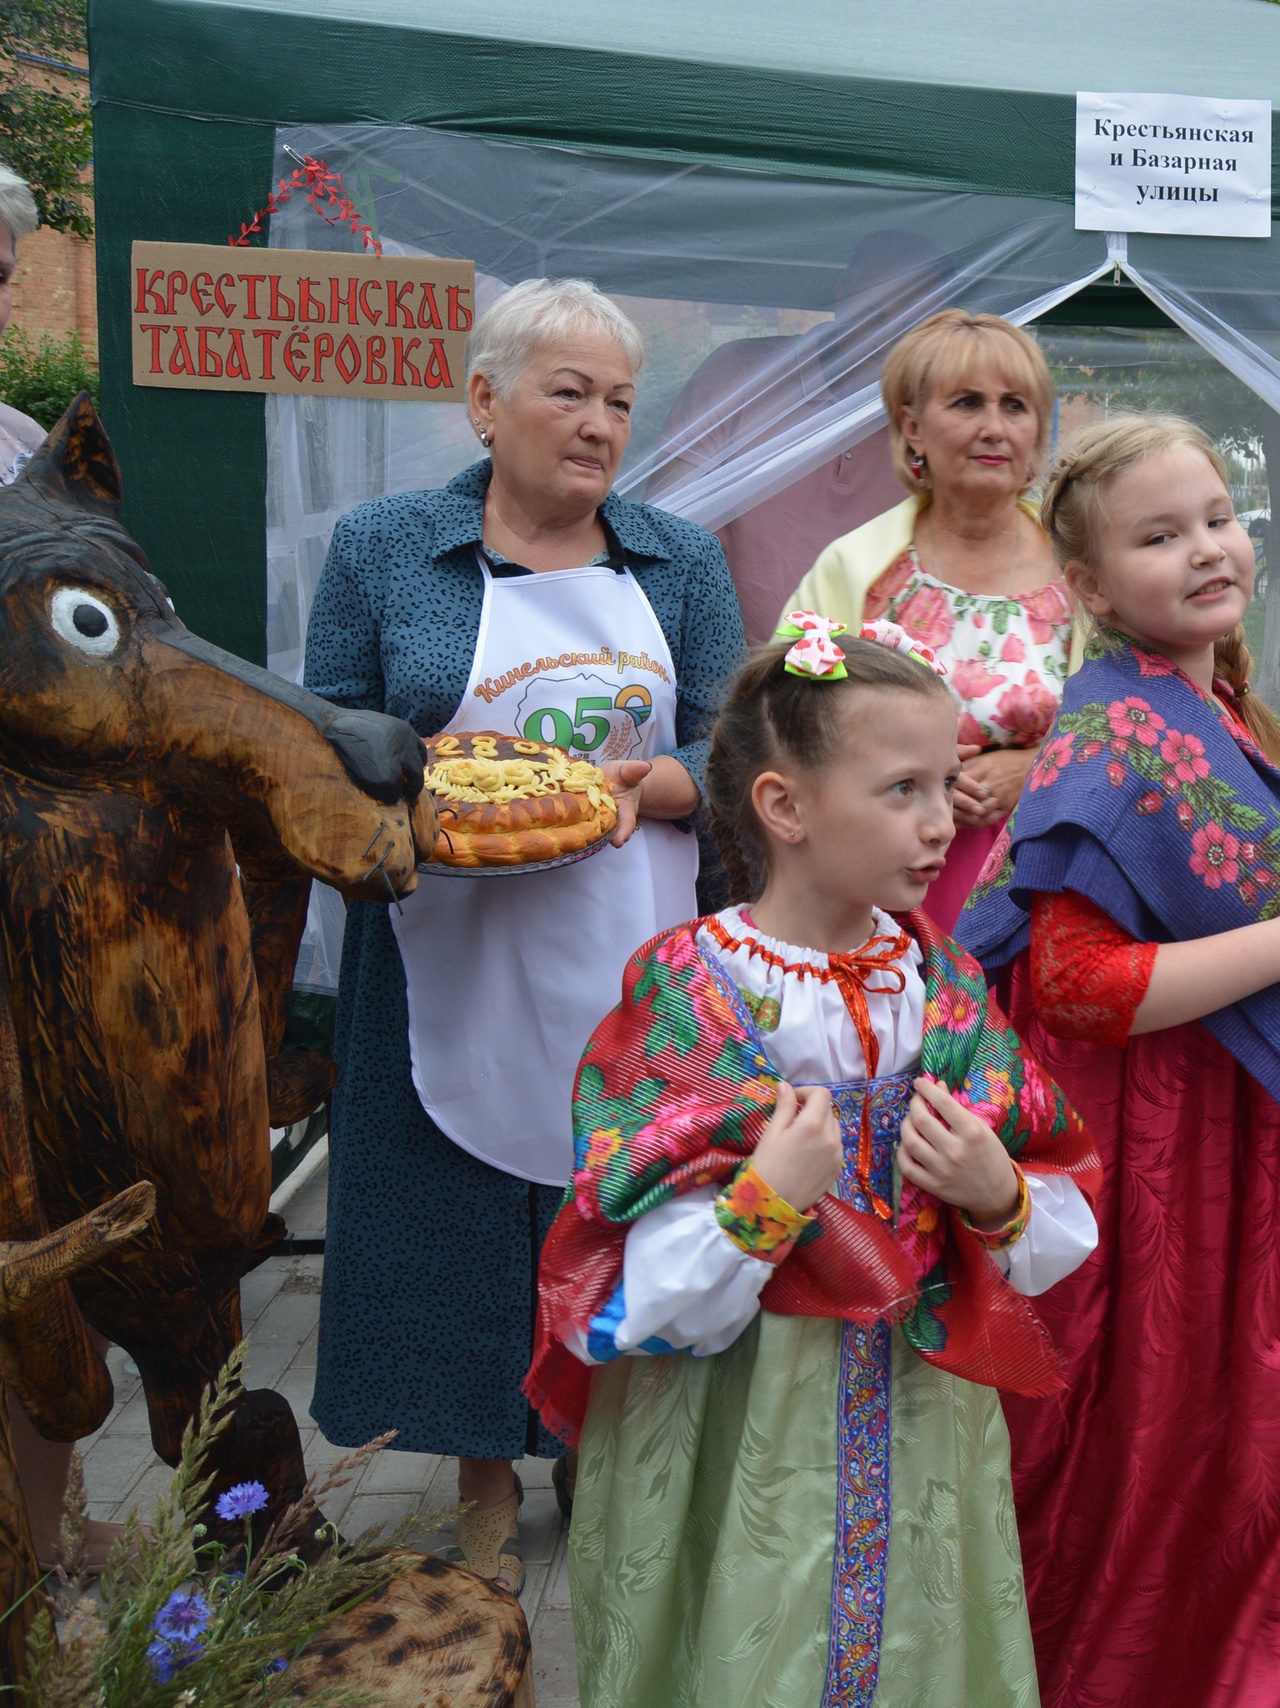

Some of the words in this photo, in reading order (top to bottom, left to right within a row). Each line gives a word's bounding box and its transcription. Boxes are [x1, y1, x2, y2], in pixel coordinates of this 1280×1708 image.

[1094, 118, 1254, 143] Крестьянская
[1110, 152, 1123, 166] и
[1131, 148, 1238, 174] Базарная
[1136, 185, 1219, 205] улицы
[140, 324, 454, 389] ТАБАТЁРОВКА
[473, 646, 616, 704] Кинельский
